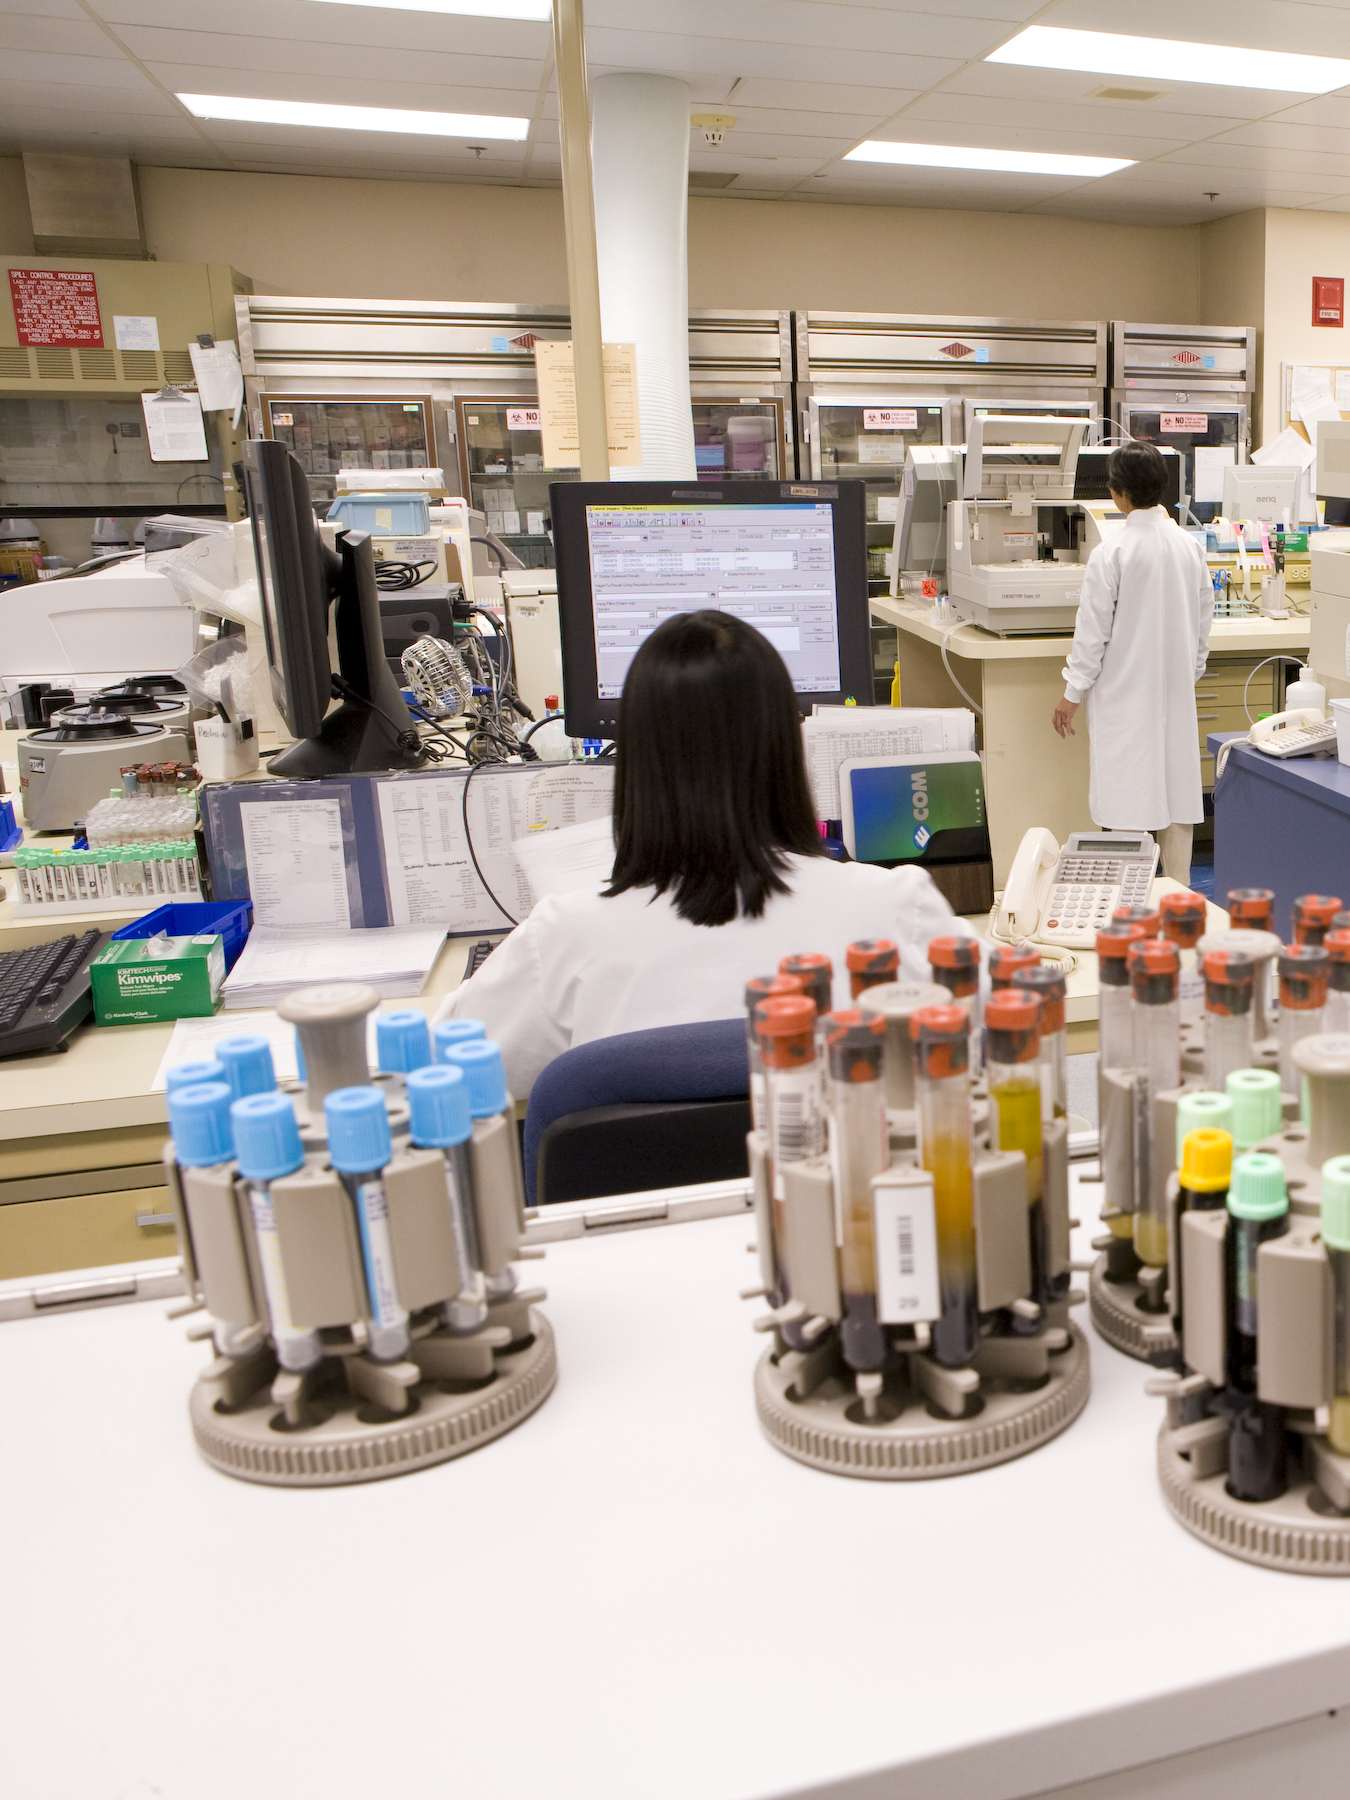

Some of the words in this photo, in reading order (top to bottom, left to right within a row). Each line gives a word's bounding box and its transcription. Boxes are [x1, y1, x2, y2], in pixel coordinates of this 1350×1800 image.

[58, 273, 94, 281] PROCEDURES
[526, 412, 537, 420] NO
[119, 972, 181, 985] Kimwipes
